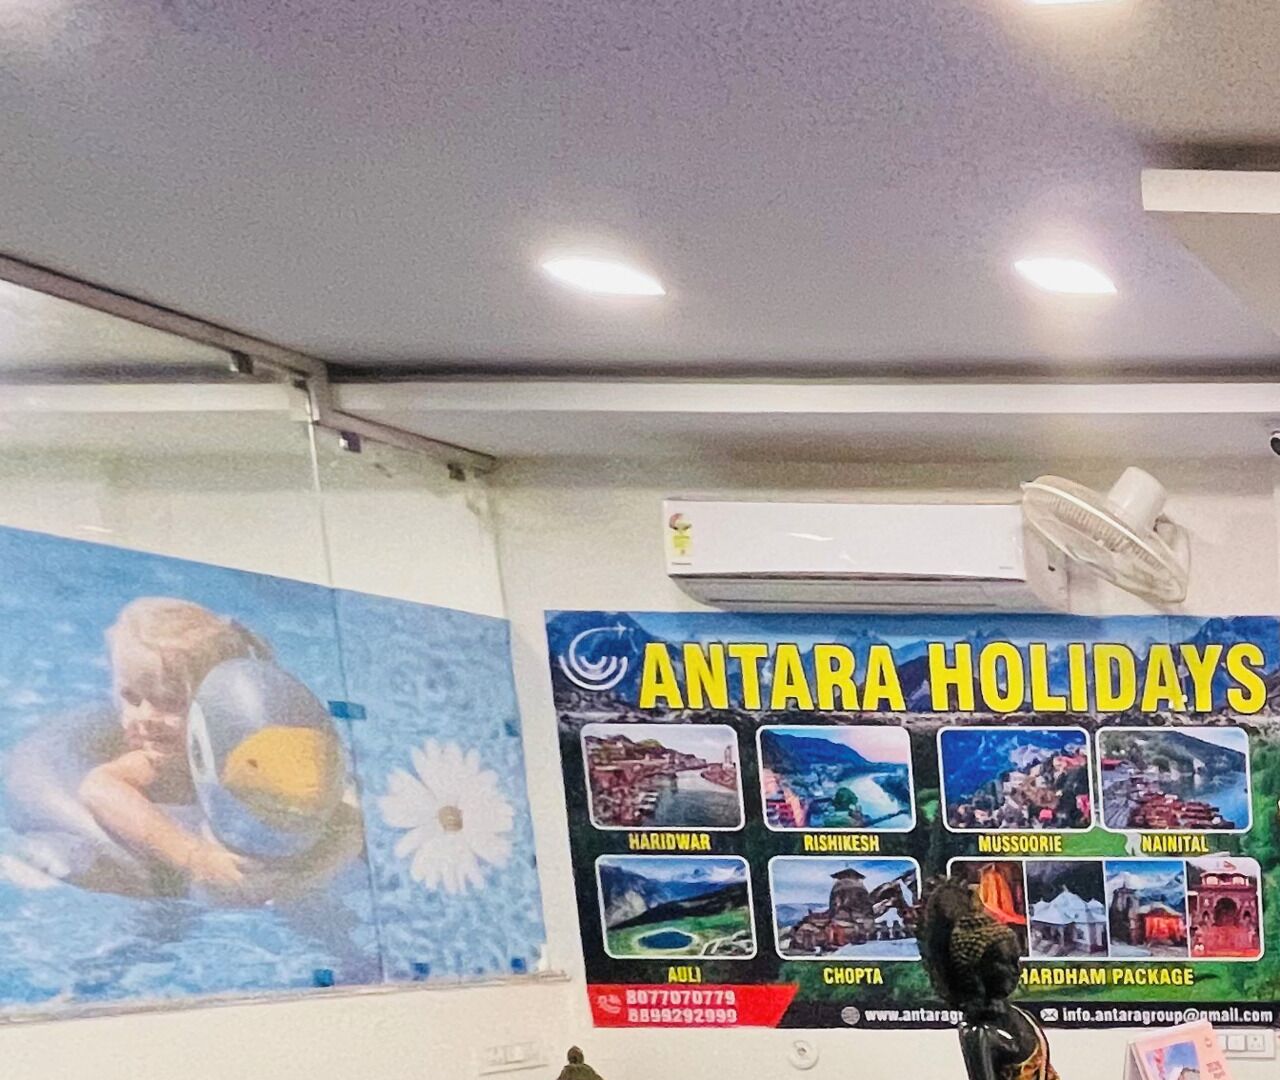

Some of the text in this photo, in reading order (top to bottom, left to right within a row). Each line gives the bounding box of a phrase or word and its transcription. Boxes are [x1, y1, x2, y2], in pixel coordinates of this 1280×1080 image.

[639, 642, 1268, 714] ANTARA HOLIDAYS
[627, 832, 712, 851] HARIDWAR
[804, 834, 881, 852] RISHIKESH
[977, 834, 1063, 853] MUSSOORIE
[1141, 834, 1210, 853] NAINITAL
[667, 965, 703, 984] AULI
[822, 967, 884, 985] CHOPTA
[1112, 968, 1195, 986] PACKAGE
[625, 989, 736, 1006] 8077070779
[864, 1007, 1274, 1026] www.antaragr info.antaragroup@gmail.com
